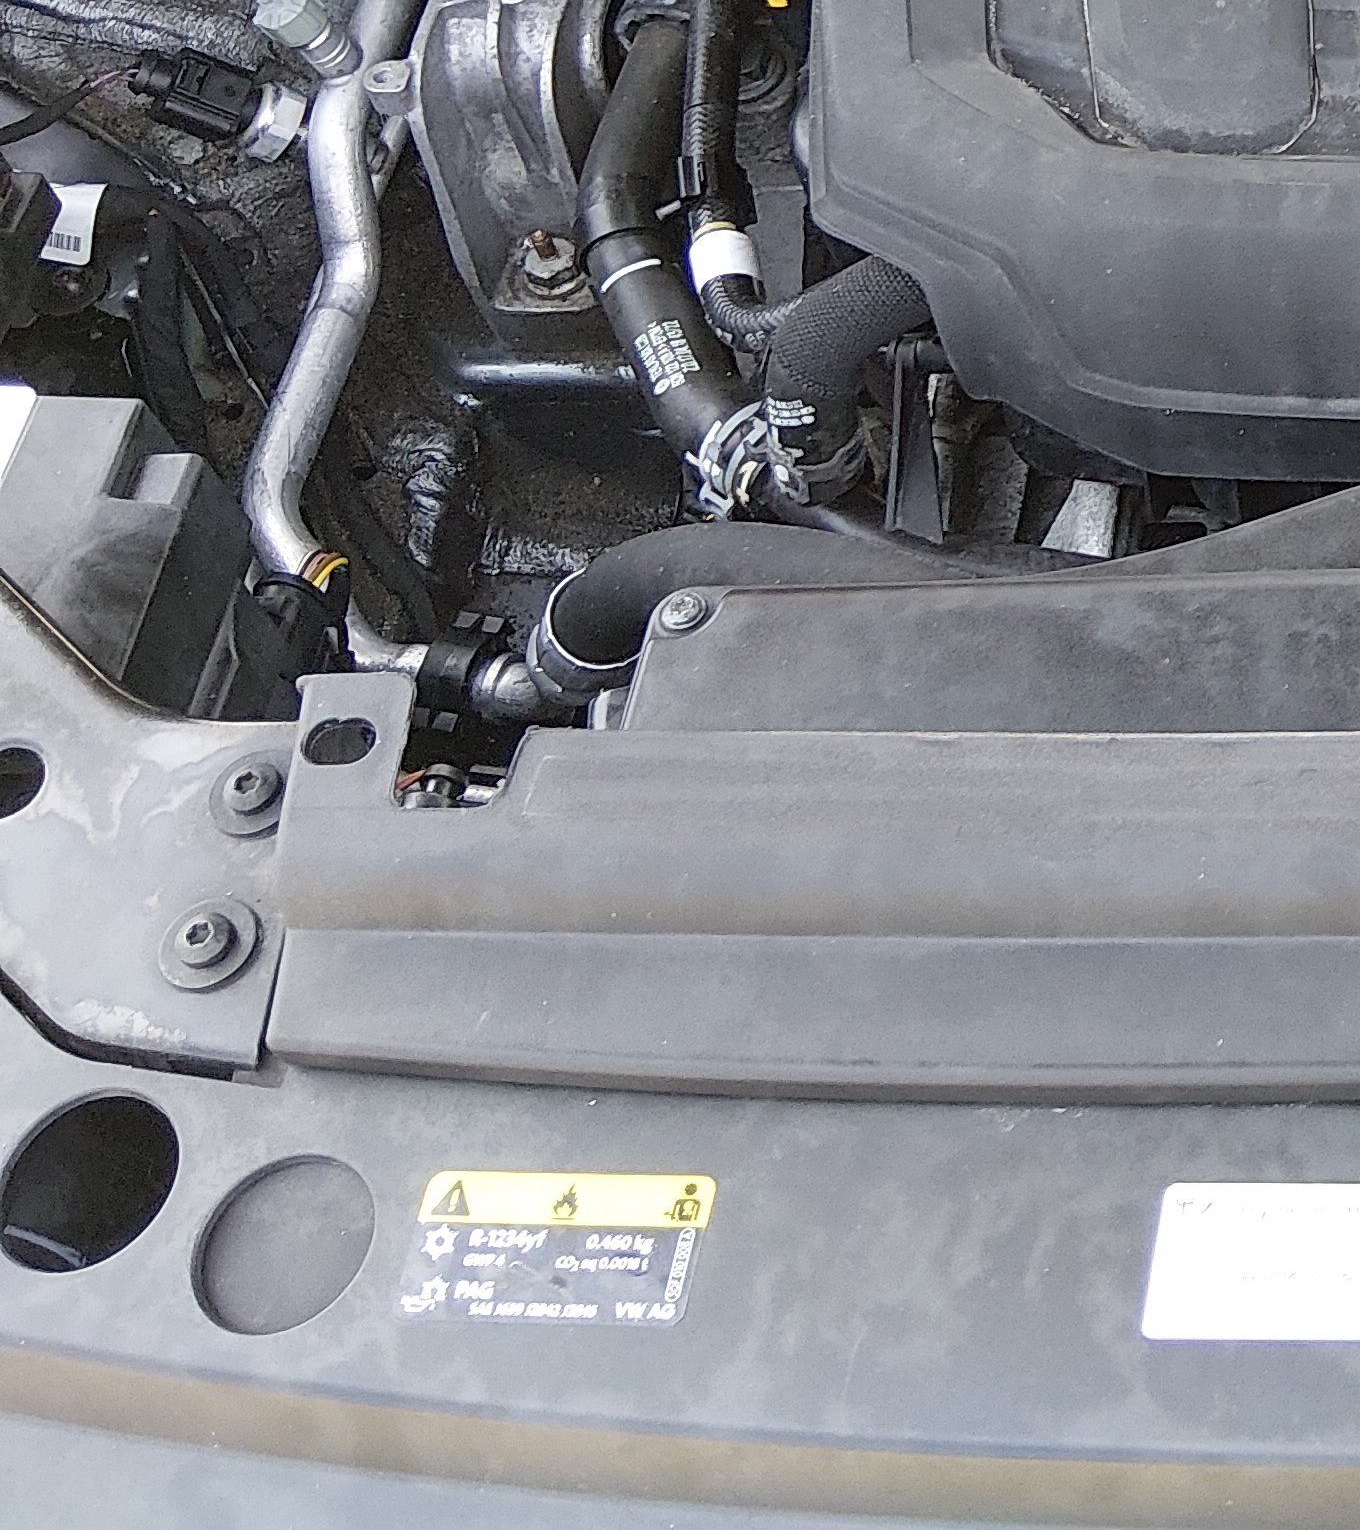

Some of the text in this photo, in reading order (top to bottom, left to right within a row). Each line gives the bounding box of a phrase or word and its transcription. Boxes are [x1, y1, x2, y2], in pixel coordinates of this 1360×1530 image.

[468, 1228, 549, 1254] R-1234yf
[633, 1234, 656, 1255] kg
[453, 1279, 495, 1300] PAG
[614, 1302, 676, 1320] VW AG
